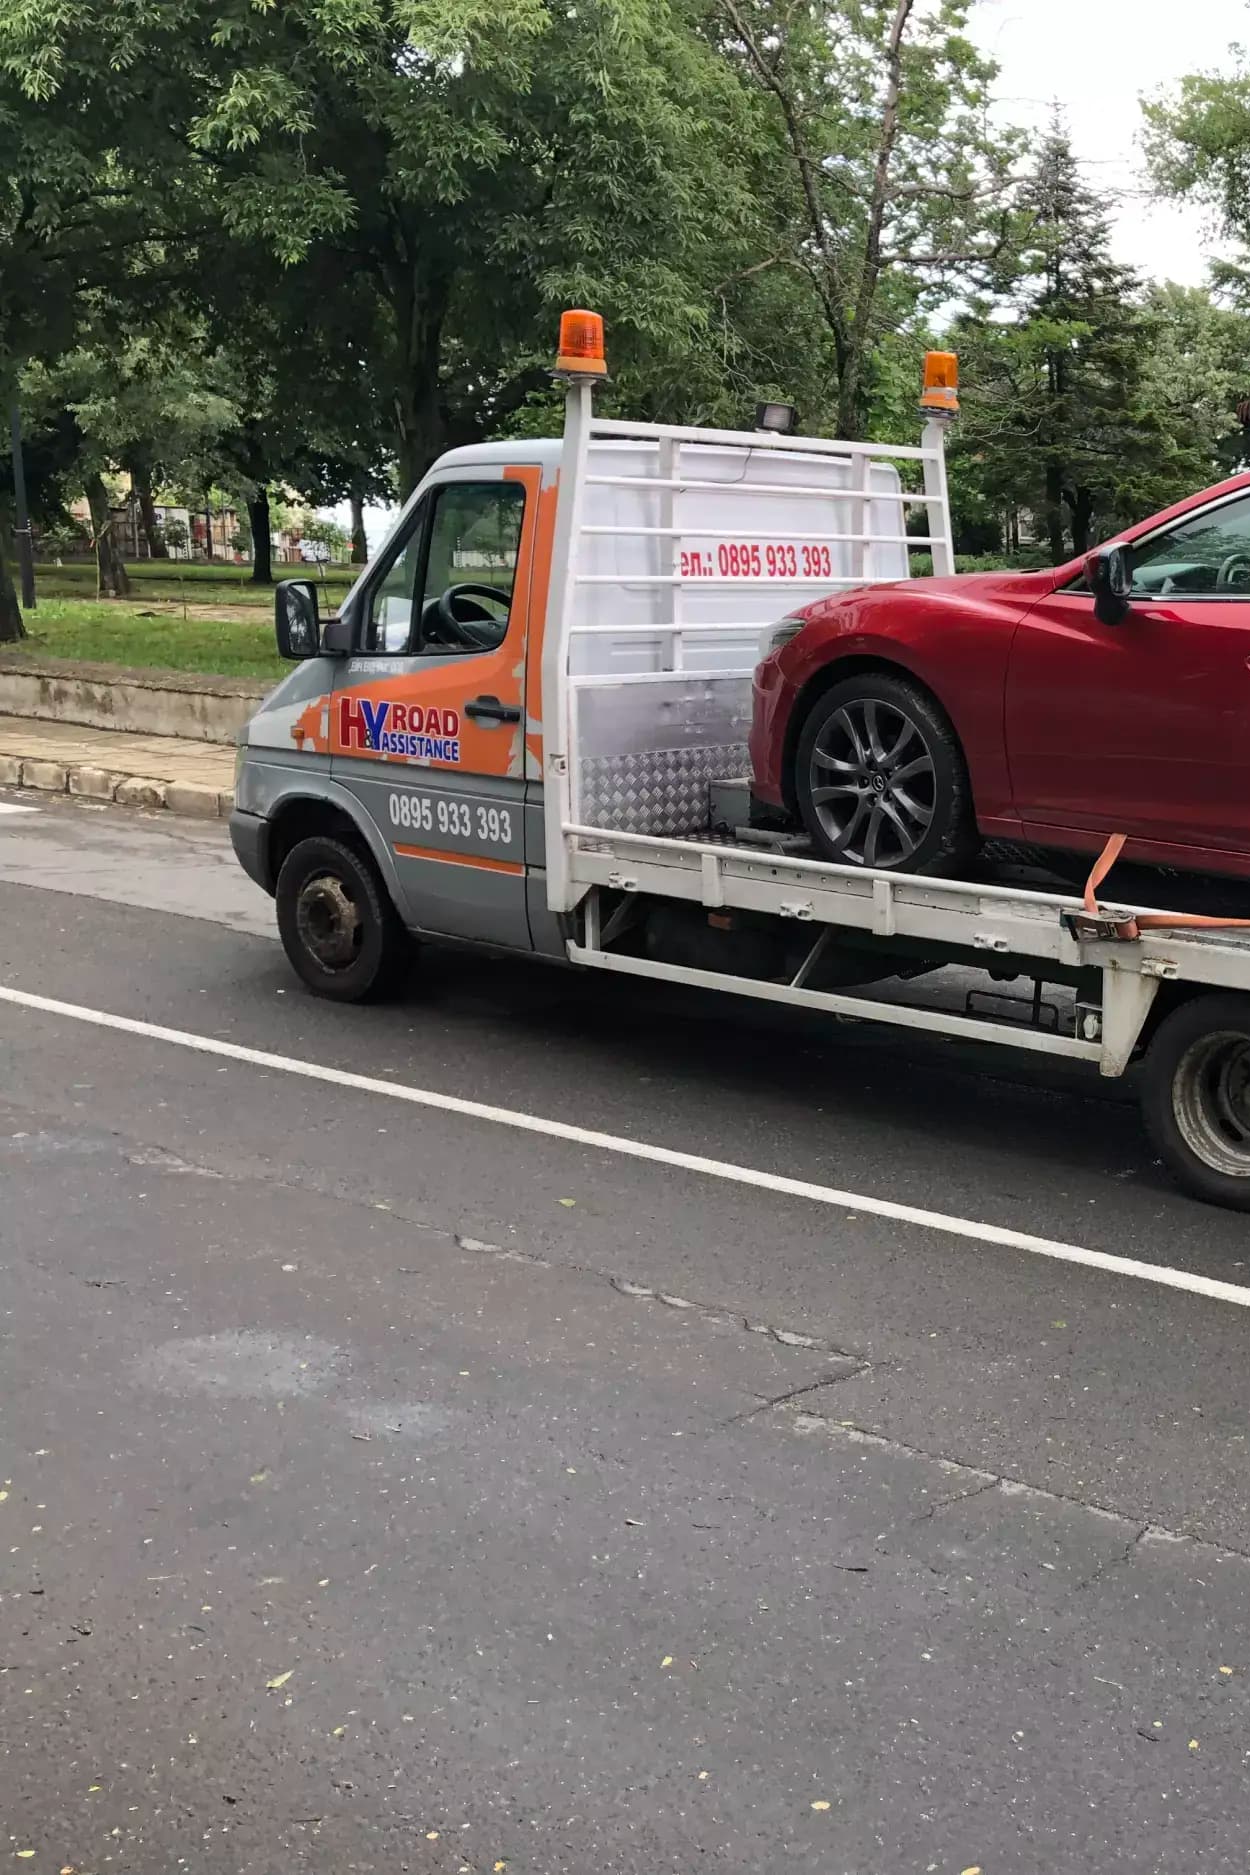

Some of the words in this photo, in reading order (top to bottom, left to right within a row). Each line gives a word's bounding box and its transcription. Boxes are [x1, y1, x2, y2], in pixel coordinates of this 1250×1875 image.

[681, 551, 713, 576] ел.:
[718, 543, 761, 577] 0895
[766, 545, 797, 577] 933
[802, 545, 832, 577] 393
[391, 702, 460, 738] ROAD
[381, 732, 460, 762] ASSISTANCE
[389, 793, 433, 831] 0895
[437, 801, 471, 837] 933
[477, 806, 512, 844] 393
